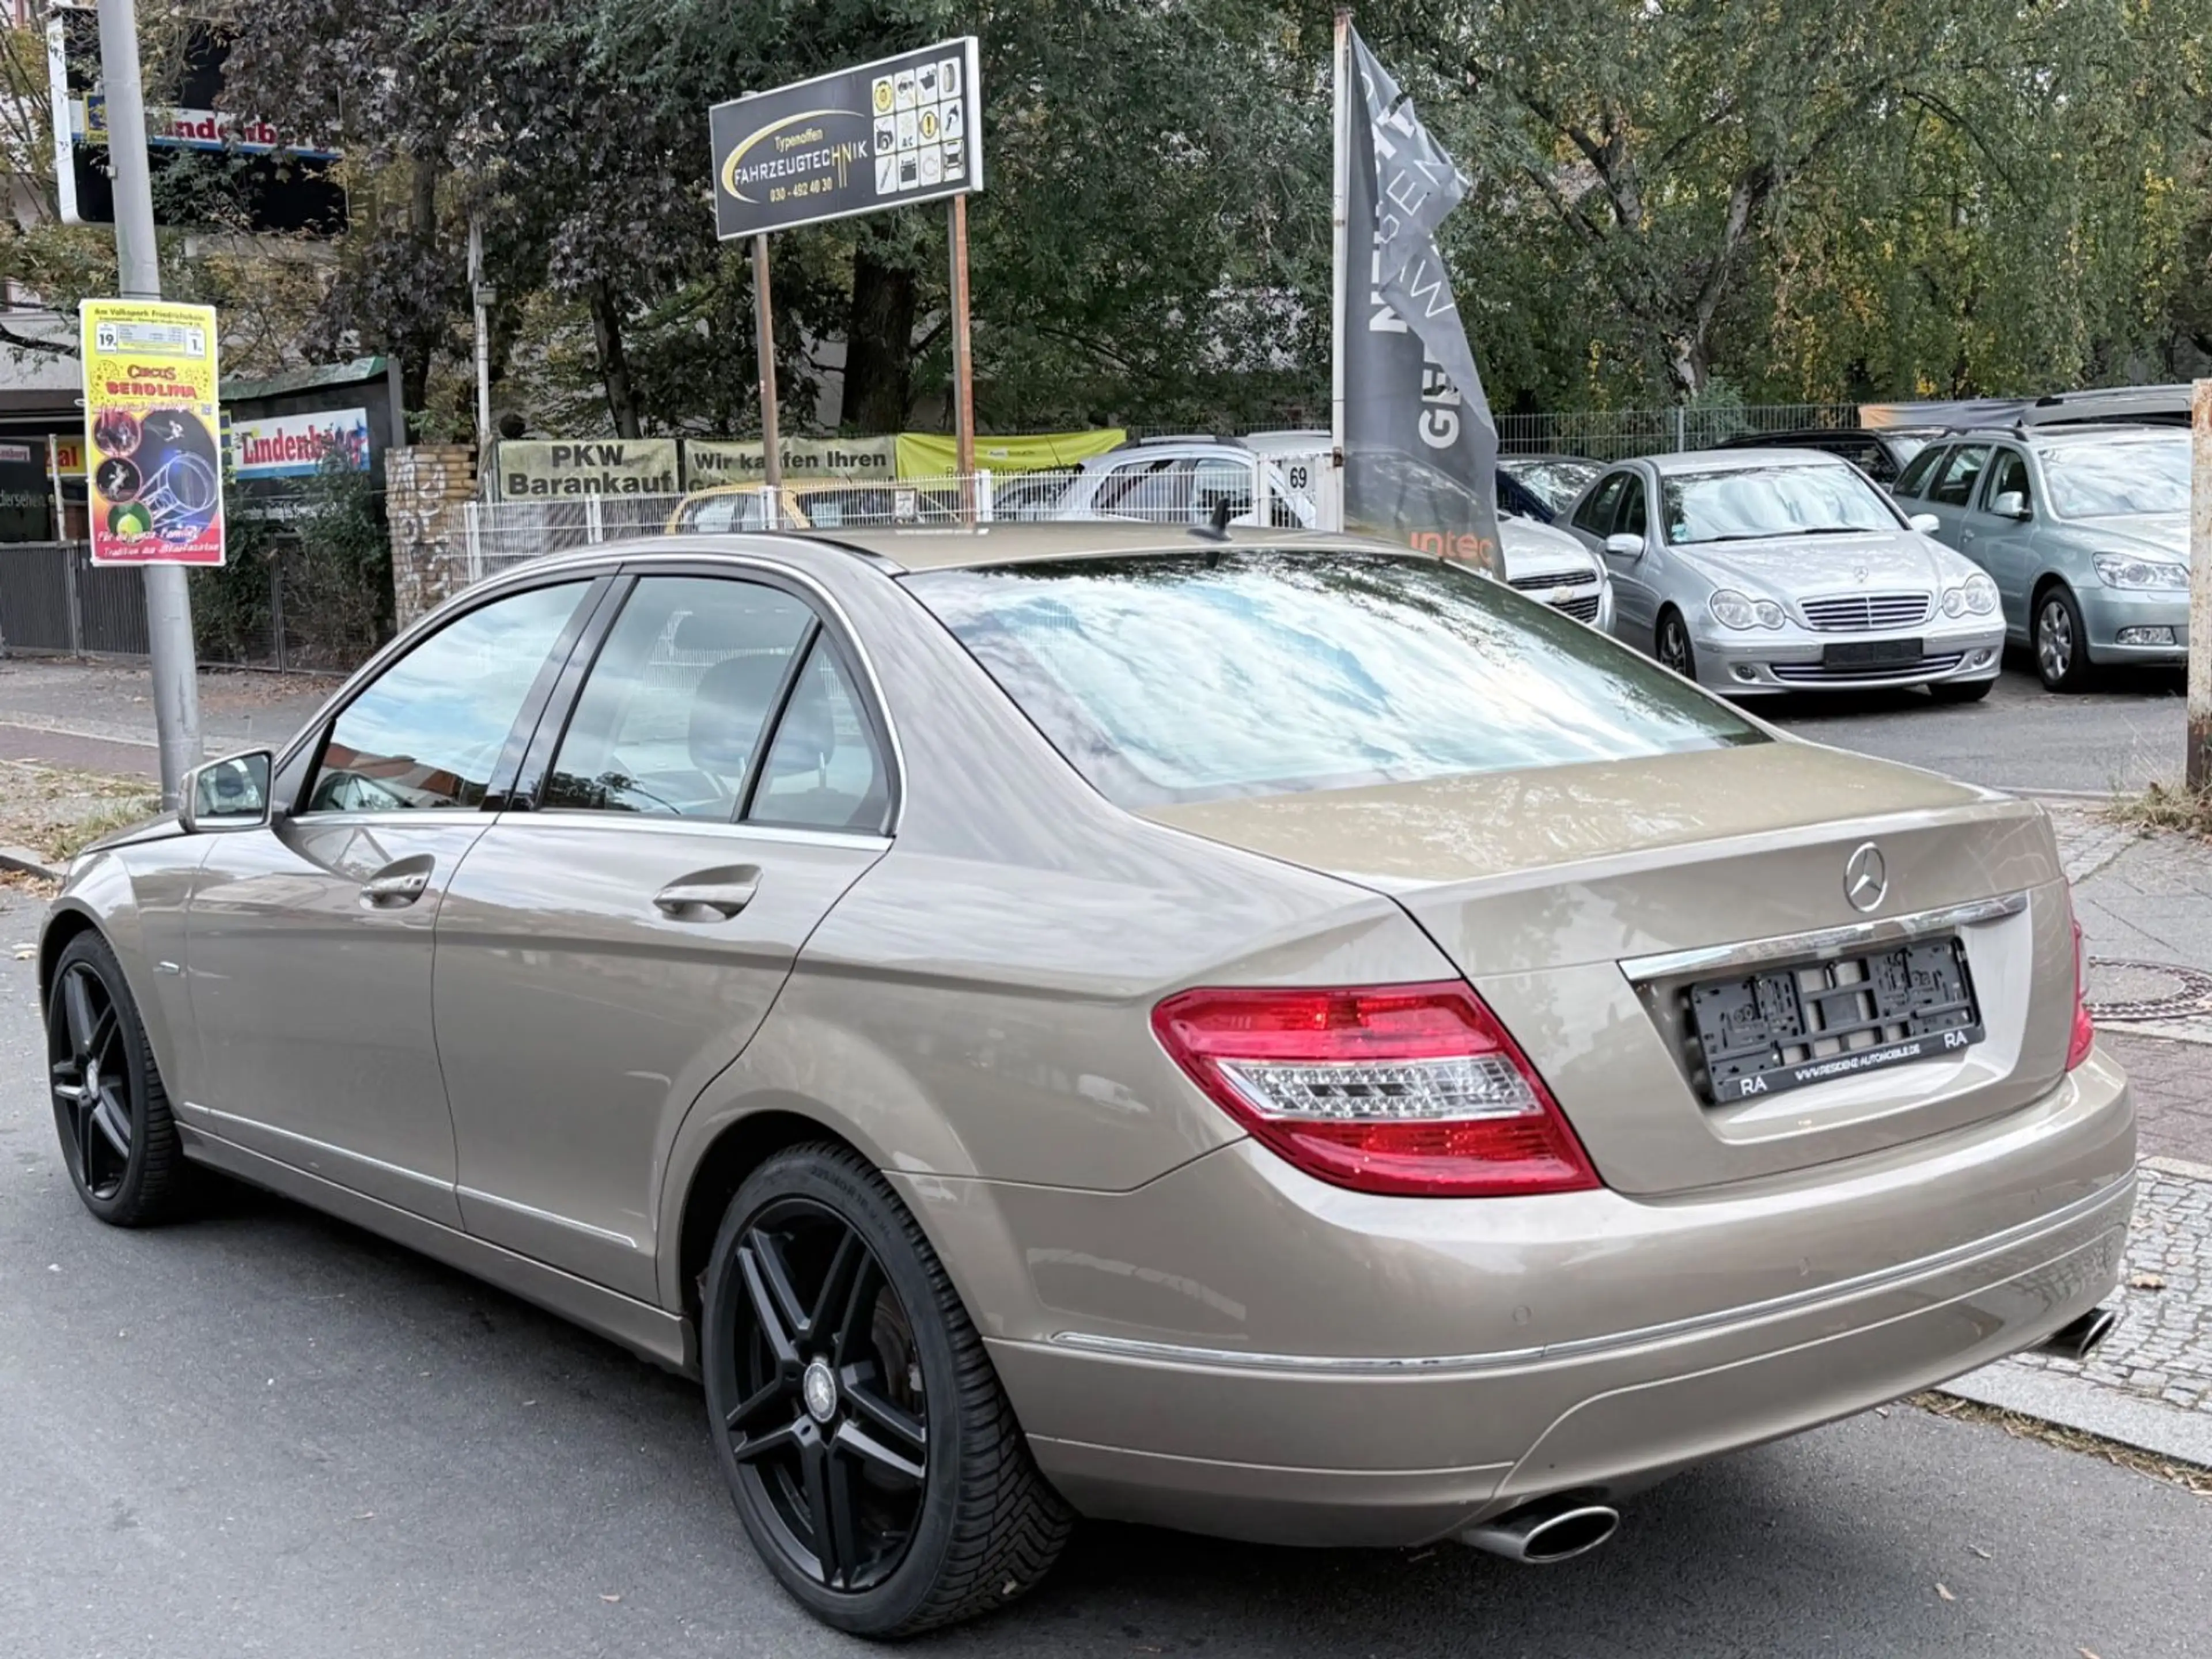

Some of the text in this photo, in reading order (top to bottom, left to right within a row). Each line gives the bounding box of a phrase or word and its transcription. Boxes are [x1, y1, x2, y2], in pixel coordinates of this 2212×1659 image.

[734, 140, 868, 188] FAHRZEUGTECHNIK
[770, 187, 786, 202] 030
[551, 445, 624, 468] PKW
[694, 450, 887, 470] Wir kafen Ihren
[508, 471, 672, 495] Barankauf
[1290, 465, 1307, 488] 69
[1741, 1077, 1767, 1096] RA
[1945, 1031, 1968, 1049] RA
